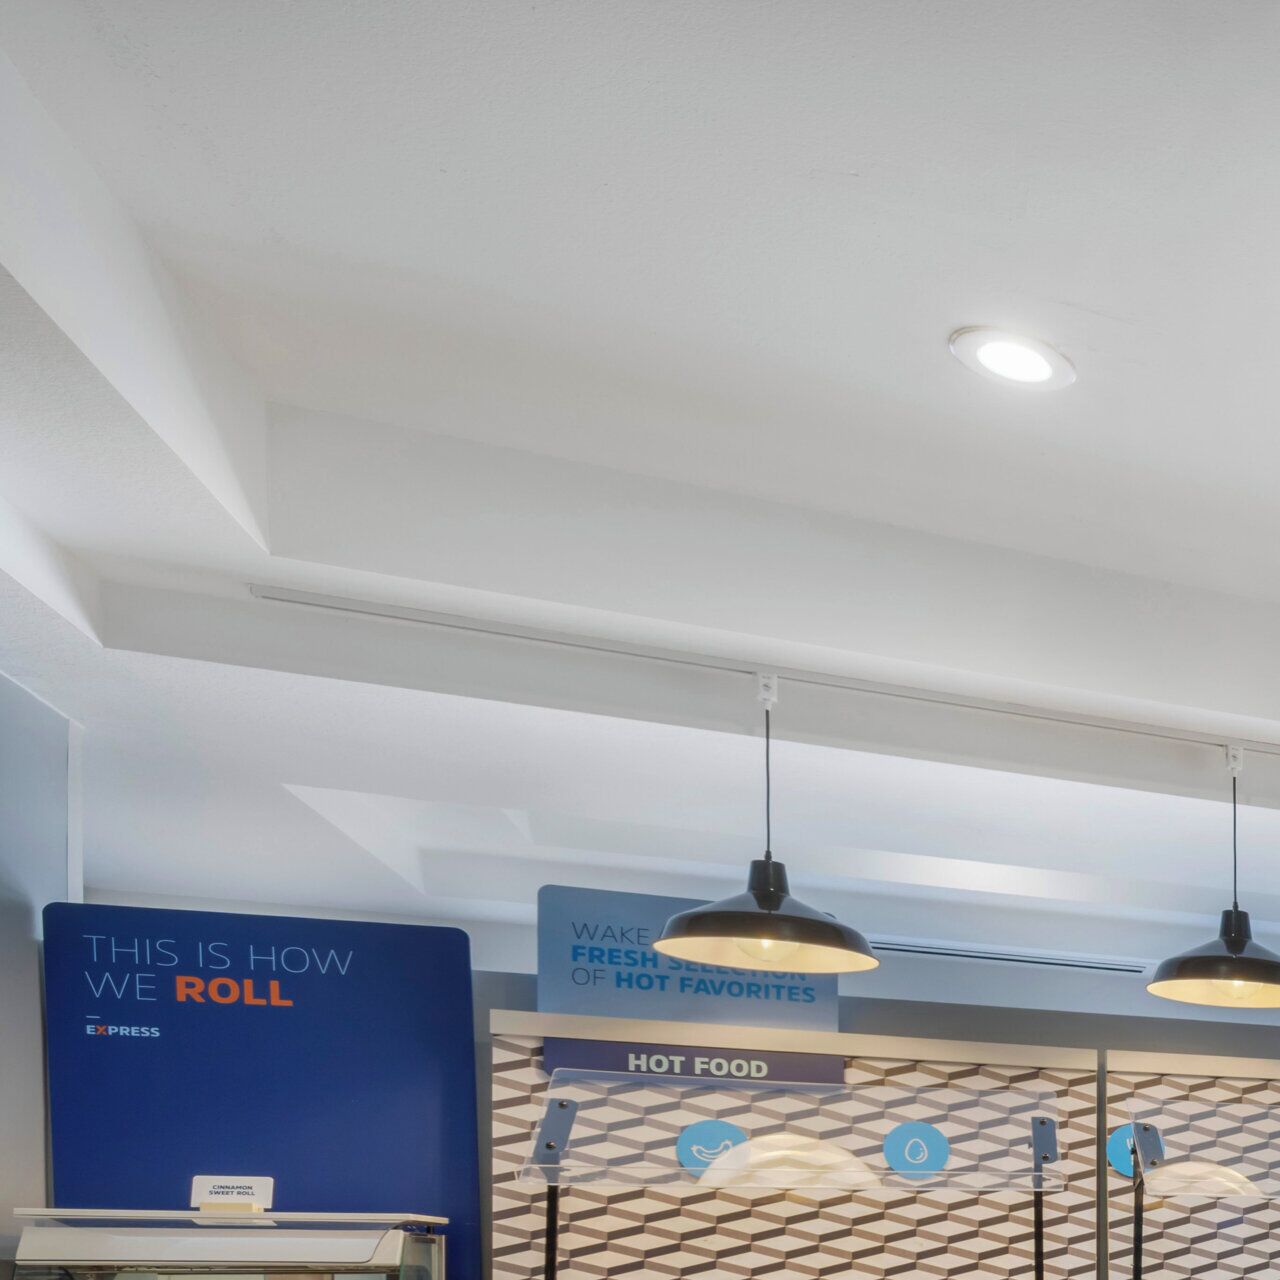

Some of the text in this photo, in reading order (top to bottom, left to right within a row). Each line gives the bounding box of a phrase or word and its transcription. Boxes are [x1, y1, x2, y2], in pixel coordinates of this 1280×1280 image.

[571, 921, 649, 946] WAKE
[83, 935, 354, 976] THIS IS HOW
[571, 944, 659, 969] FRESH
[85, 971, 294, 1007] WE ROLL
[571, 968, 817, 1004] OF HOT FAVORITES
[85, 1024, 161, 1038] EXPRESS
[628, 1053, 769, 1079] HOT FOOD
